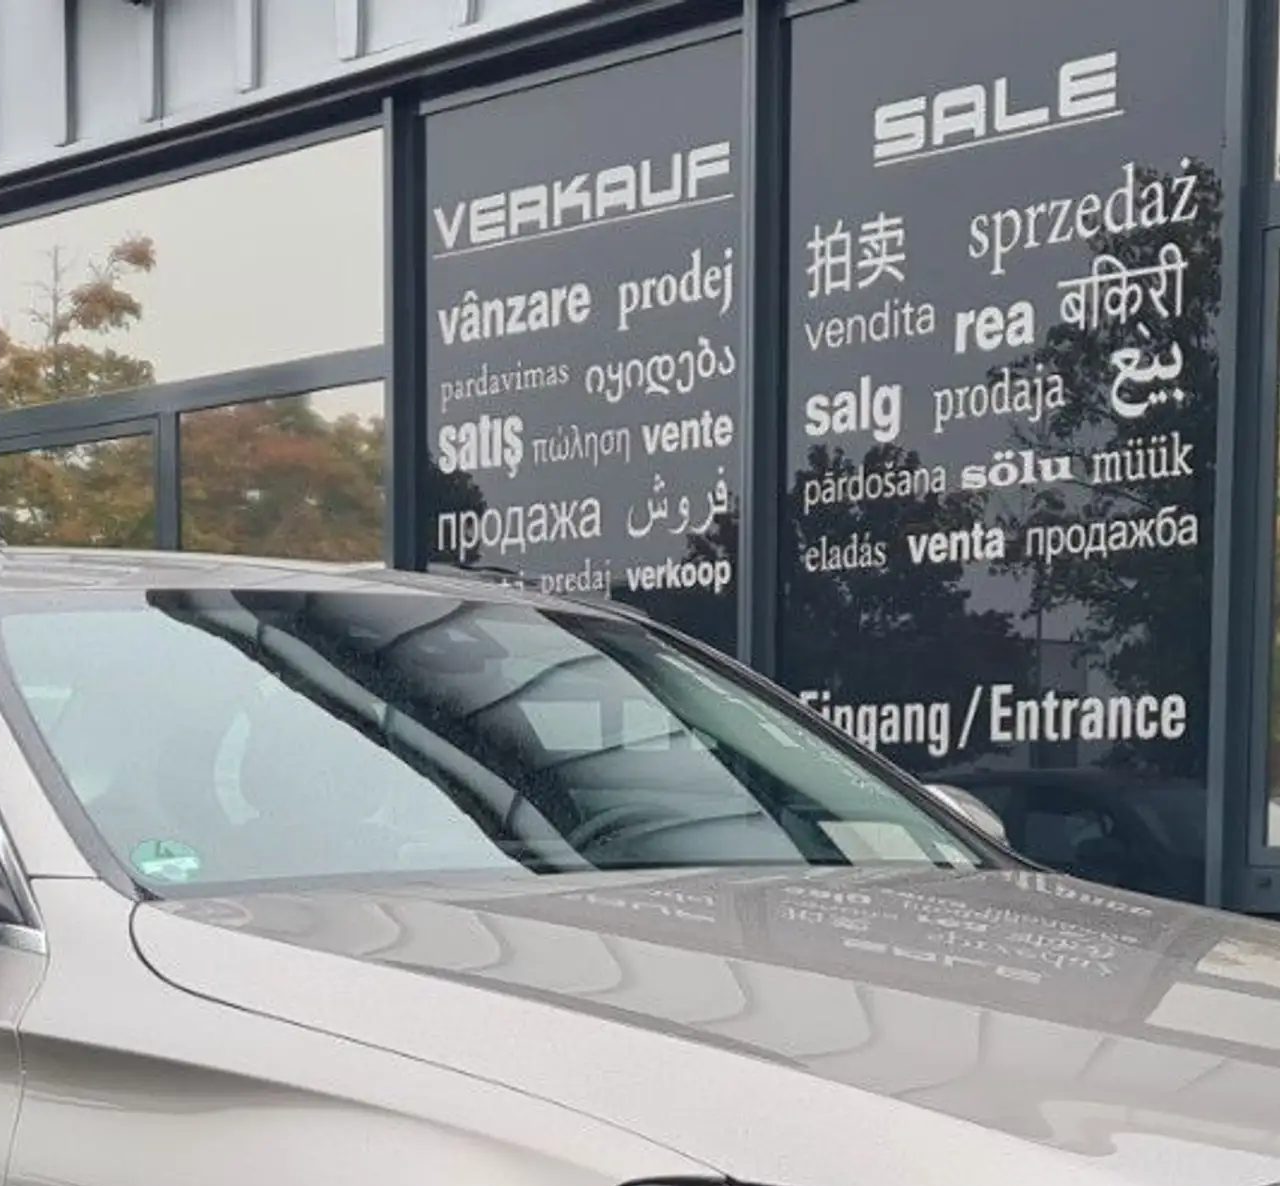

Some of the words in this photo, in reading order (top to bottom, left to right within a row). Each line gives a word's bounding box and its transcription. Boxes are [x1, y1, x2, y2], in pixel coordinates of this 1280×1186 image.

[874, 52, 1118, 159] SALE
[433, 141, 730, 249] VERKAUF
[968, 156, 1199, 276] sprzedaż
[806, 211, 906, 298] 拍卖
[438, 283, 591, 345] vânzare
[618, 247, 733, 331] prodej
[804, 298, 935, 350] vendita
[955, 301, 1034, 354] rea
[440, 361, 570, 413] pardavimas
[805, 375, 901, 442] salg
[933, 363, 1066, 433] prodaja
[438, 415, 524, 479] satış
[532, 424, 630, 467] πώληση
[641, 410, 734, 454] vente
[961, 448, 1074, 489] sölu
[1092, 431, 1194, 485] müük
[438, 497, 602, 562] продажа
[628, 466, 728, 538] فروش
[805, 532, 887, 571] eladás
[907, 522, 1005, 563] venta
[1026, 505, 1199, 563] продажба
[626, 556, 732, 594] verkoop
[990, 684, 1187, 743] Entrance
